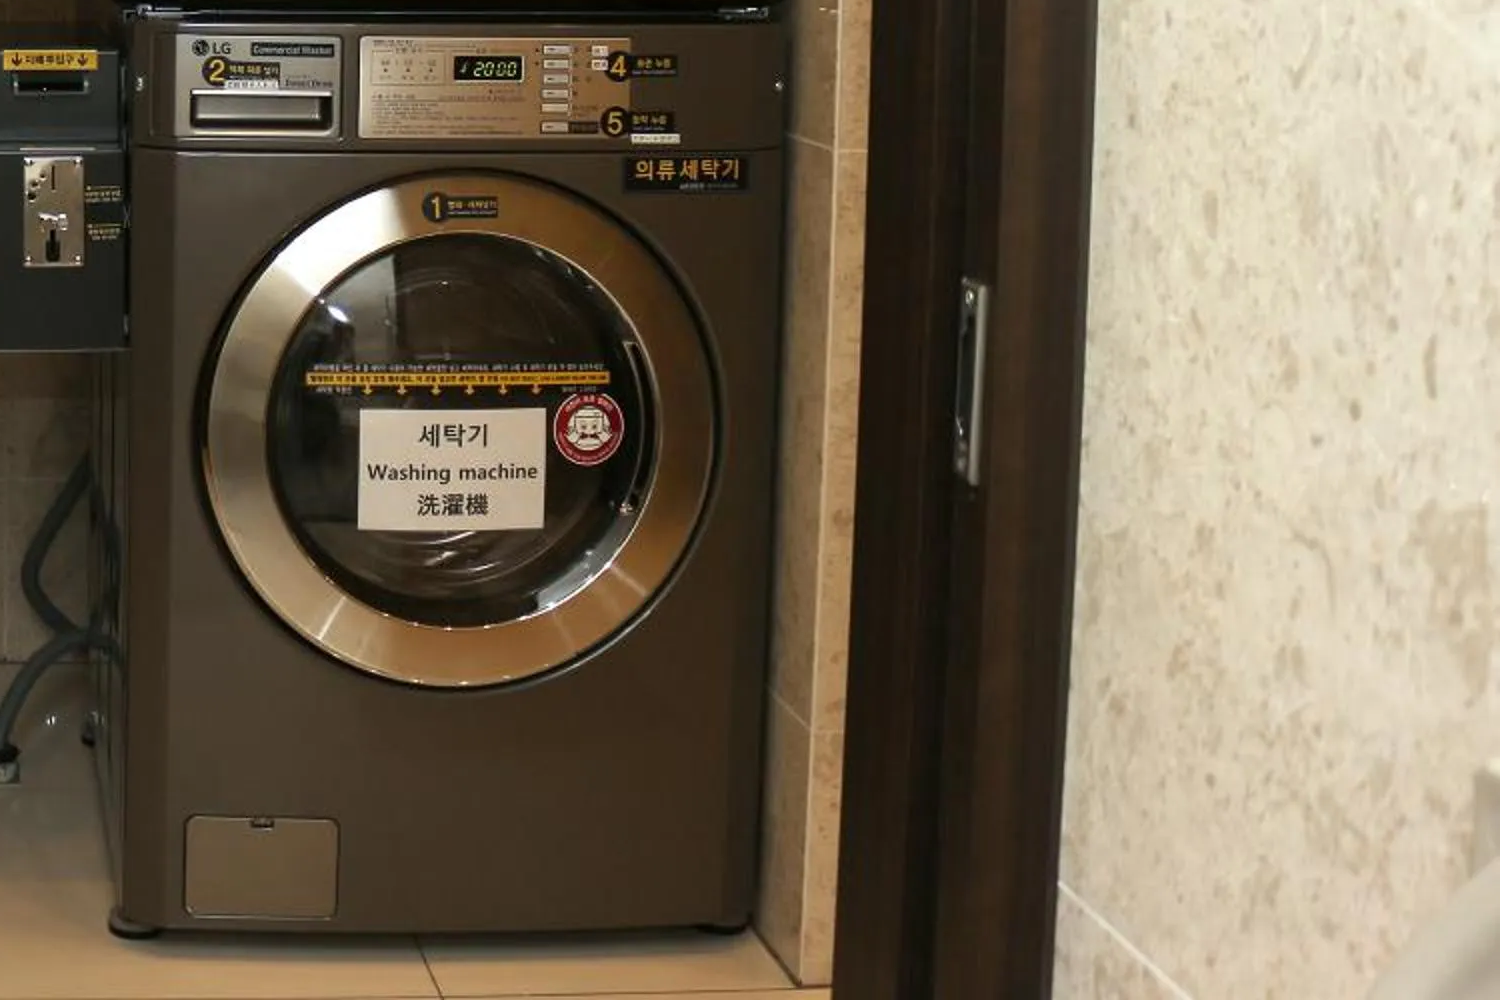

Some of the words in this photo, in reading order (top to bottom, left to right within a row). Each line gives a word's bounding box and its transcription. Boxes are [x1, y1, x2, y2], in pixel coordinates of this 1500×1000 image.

[213, 42, 233, 55] LG
[209, 59, 225, 82] 2
[610, 55, 627, 77] 4
[607, 111, 623, 135] 5
[635, 158, 739, 181] 의류세탁기
[431, 197, 441, 219] 1
[418, 423, 489, 448] 세탁기
[367, 463, 451, 485] Washing
[459, 463, 538, 481] machine
[417, 493, 489, 517] 洗濯機
